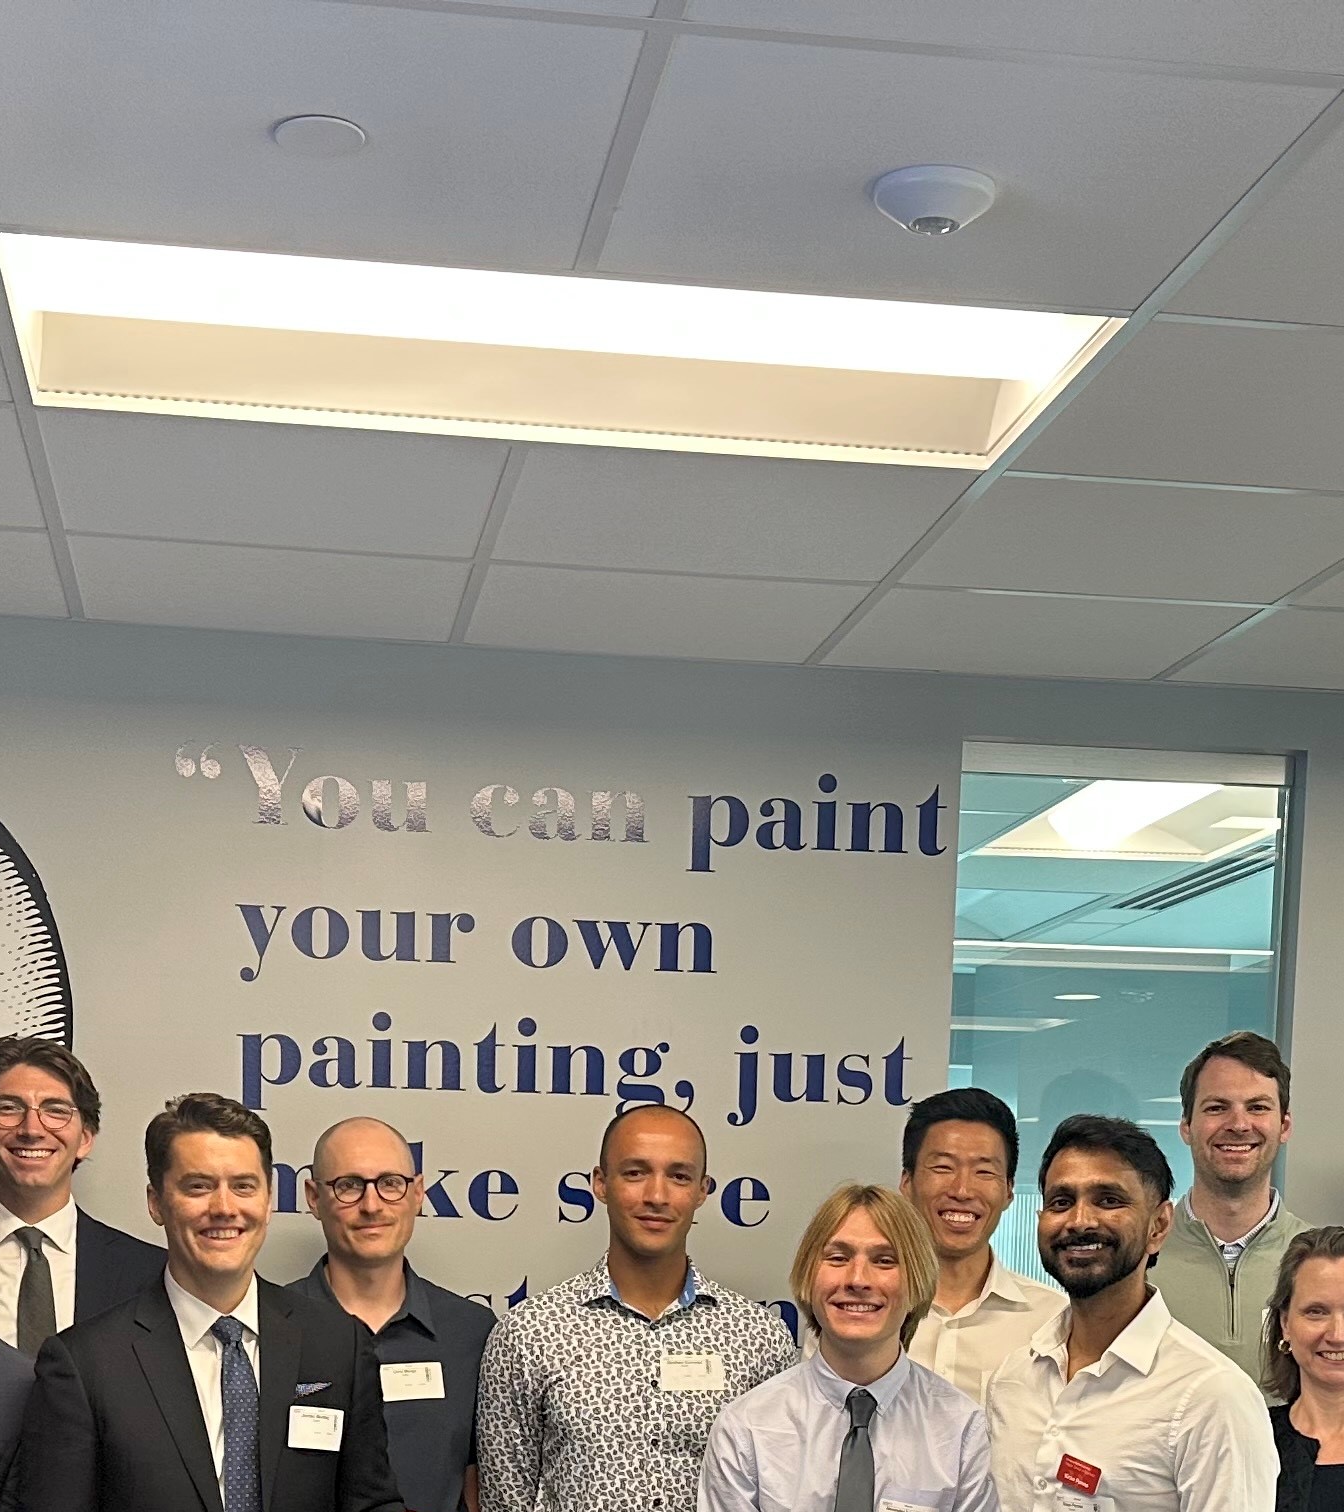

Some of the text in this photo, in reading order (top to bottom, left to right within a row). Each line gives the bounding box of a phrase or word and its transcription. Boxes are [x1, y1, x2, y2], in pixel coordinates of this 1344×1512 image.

[470, 782, 649, 843] can
[686, 773, 948, 873] paint
[236, 900, 717, 982] your own
[236, 1011, 914, 1126] painting, just
[271, 1141, 771, 1227] ke se
